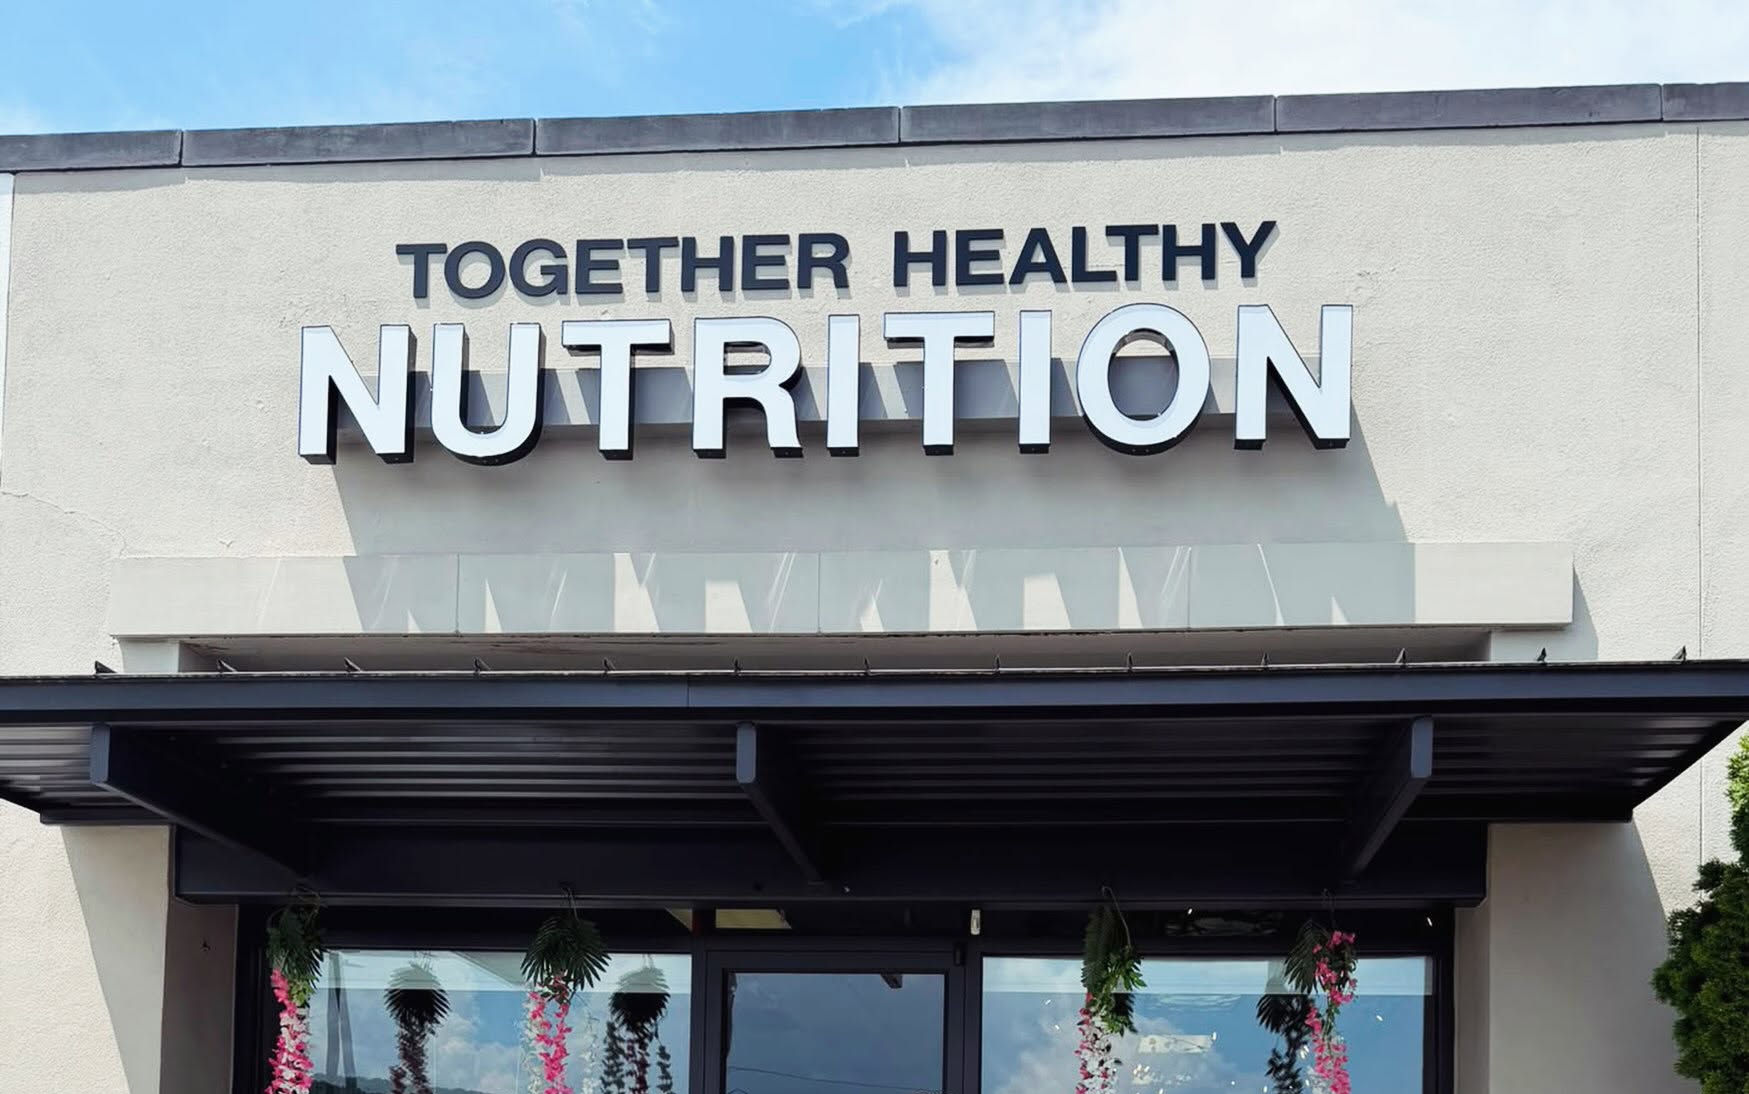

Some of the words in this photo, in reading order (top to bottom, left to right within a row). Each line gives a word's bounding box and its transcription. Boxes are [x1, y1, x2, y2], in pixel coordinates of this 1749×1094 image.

[396, 232, 850, 300] TOGETHER
[892, 220, 1277, 289] HEALTHY
[297, 303, 1354, 466] NUTRITION
